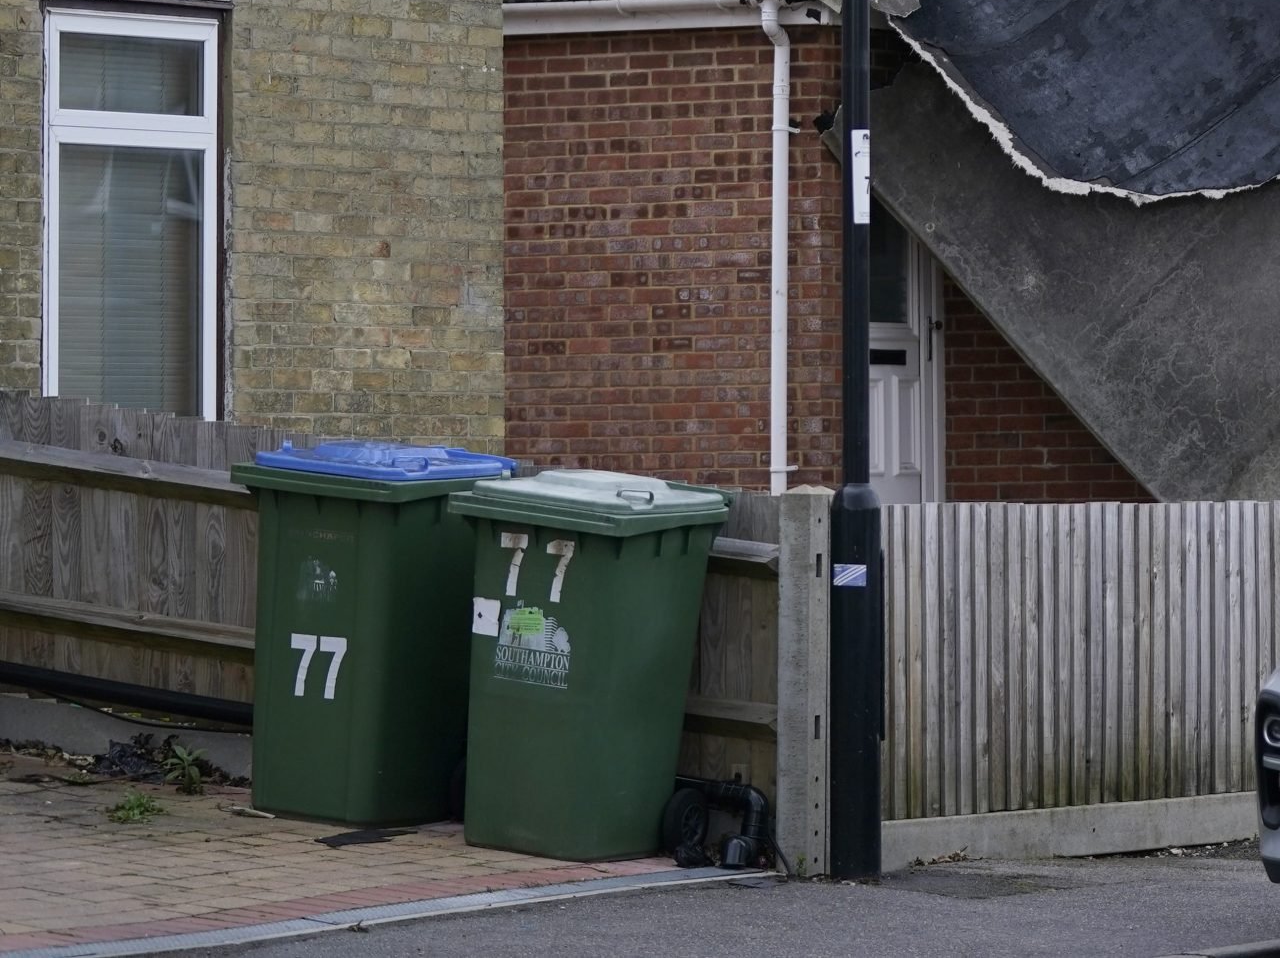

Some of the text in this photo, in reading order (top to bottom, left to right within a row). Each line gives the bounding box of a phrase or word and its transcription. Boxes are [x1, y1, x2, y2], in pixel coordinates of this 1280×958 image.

[291, 632, 348, 700] 77
[495, 645, 570, 671] SOUTHAMPTON
[522, 666, 568, 687] COUNCIL
